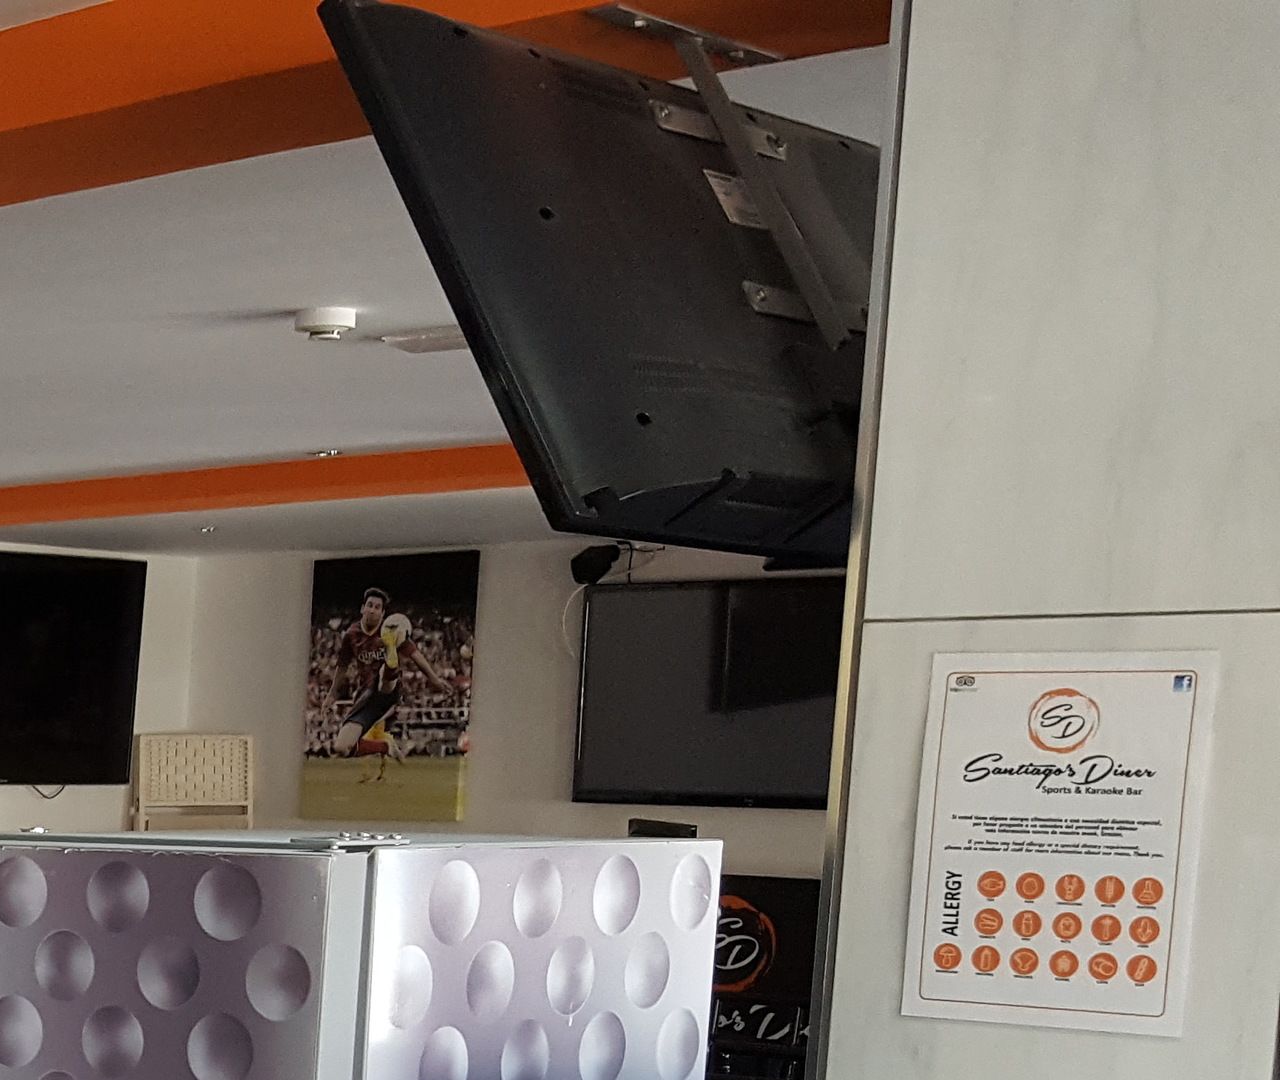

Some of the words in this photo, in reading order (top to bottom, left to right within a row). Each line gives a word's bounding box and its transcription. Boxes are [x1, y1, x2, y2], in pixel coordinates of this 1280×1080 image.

[963, 753, 1077, 789] Santiago's
[1071, 755, 1158, 785] Diner
[1041, 785, 1072, 795] Sports
[1074, 786, 1082, 794] &
[1085, 786, 1124, 796] Karaoke
[1126, 787, 1144, 796] Bar
[941, 870, 963, 937] ALLERGY
